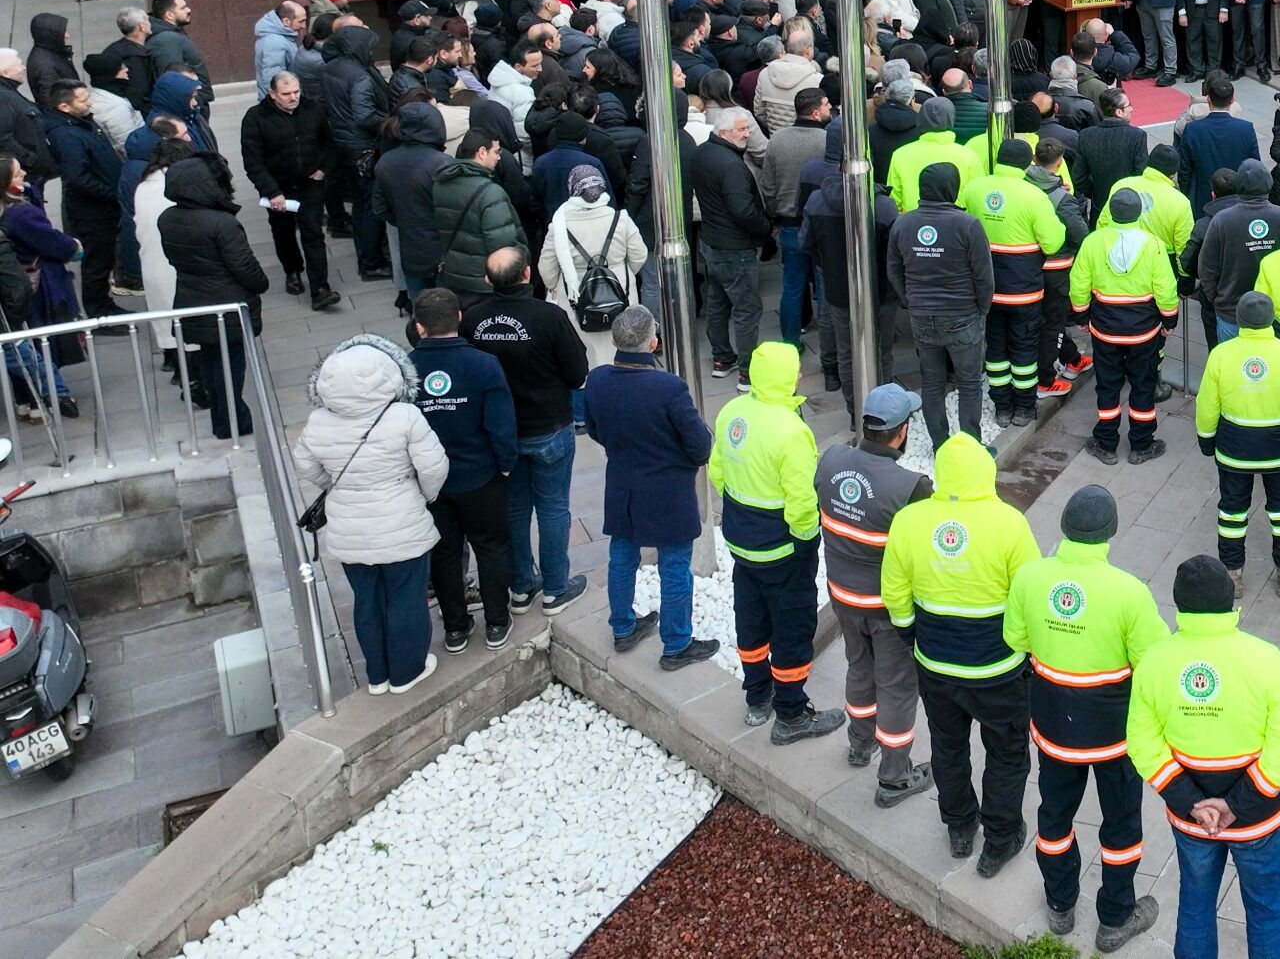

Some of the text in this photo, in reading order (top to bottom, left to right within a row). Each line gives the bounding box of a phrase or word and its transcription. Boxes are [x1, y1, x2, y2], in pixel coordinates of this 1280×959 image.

[6, 725, 60, 757] 40 ACG
[28, 743, 56, 762] 143
